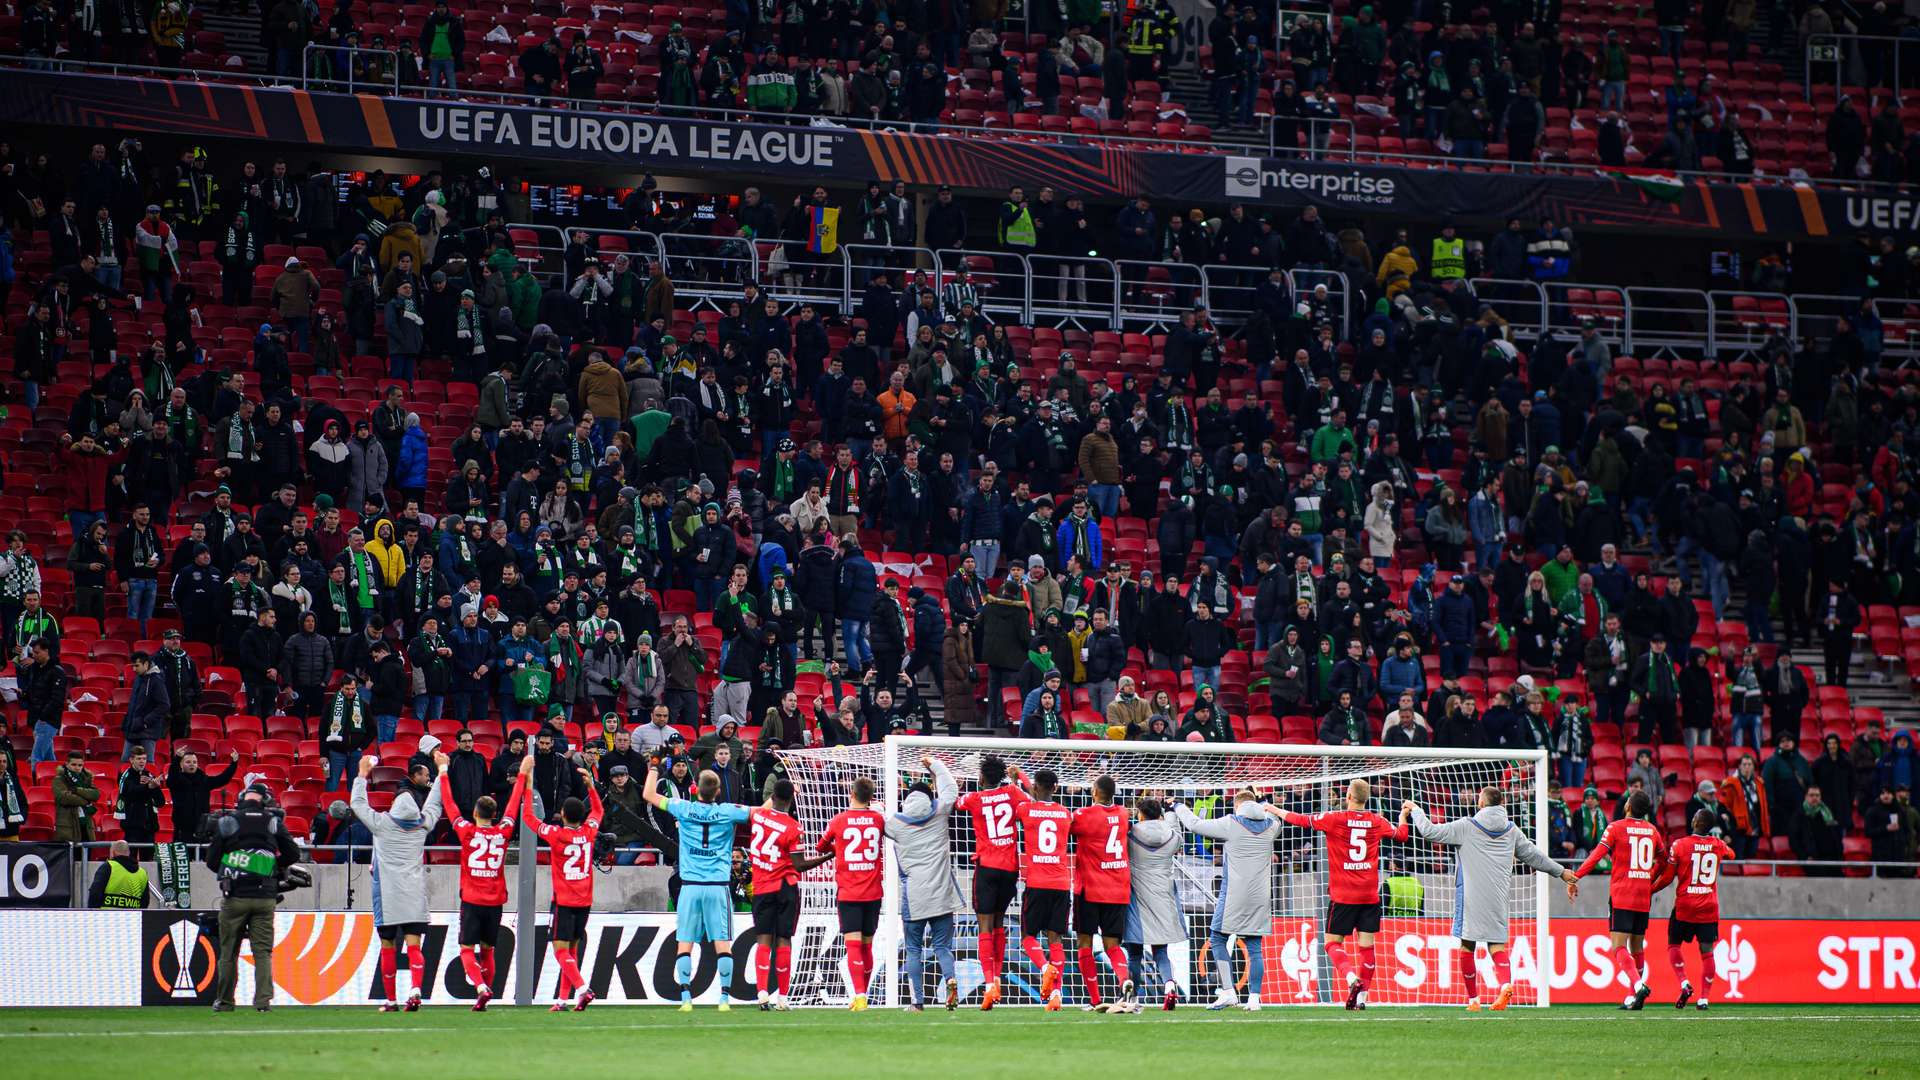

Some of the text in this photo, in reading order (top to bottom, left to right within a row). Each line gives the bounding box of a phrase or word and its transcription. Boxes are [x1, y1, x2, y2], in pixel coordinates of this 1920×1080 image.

[420, 106, 520, 145] UEFA
[531, 115, 679, 157] EUROPA
[689, 126, 833, 167] LEAGUE
[1227, 166, 1395, 196] enterprise
[1336, 192, 1394, 204] rent-a-car
[702, 823, 710, 848] 1
[982, 802, 1014, 839] 12
[1038, 819, 1058, 854] 6
[468, 837, 505, 869] 25
[563, 842, 592, 874] 21
[750, 823, 781, 863] 24
[842, 827, 880, 862] 23
[1105, 825, 1123, 859] 4
[1349, 828, 1367, 861] 5
[1629, 836, 1654, 871] 10
[1694, 843, 1713, 851] DIABY
[228, 852, 250, 868] HB
[1690, 852, 1718, 885] 19
[1817, 935, 1920, 990] STR
